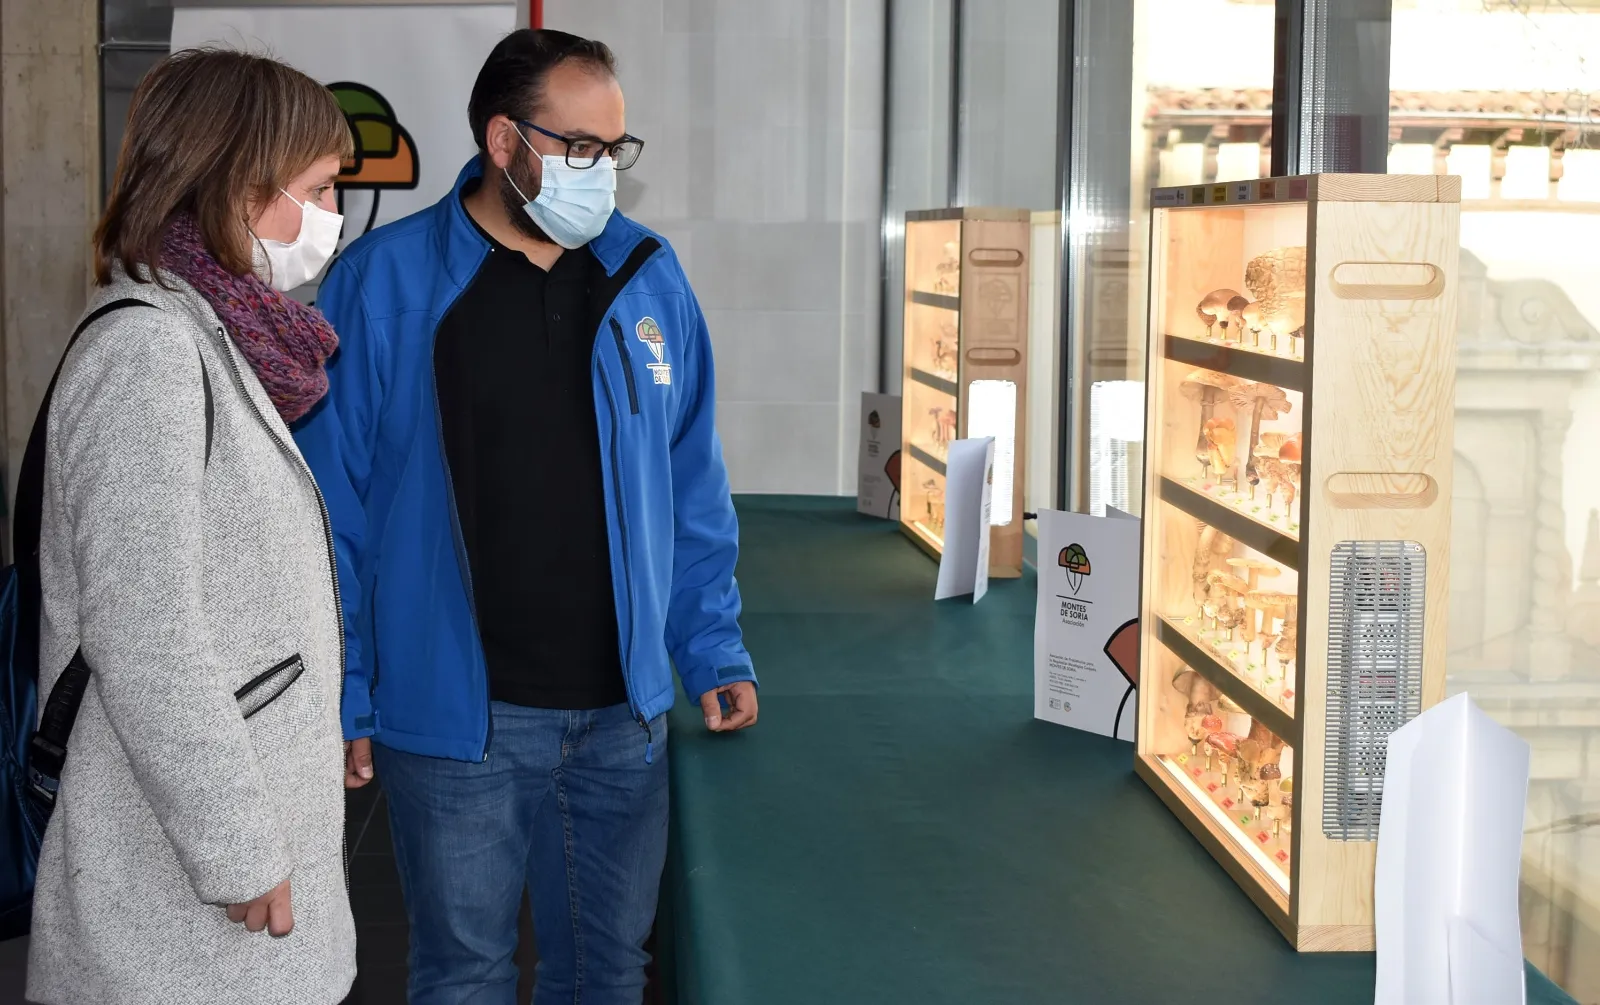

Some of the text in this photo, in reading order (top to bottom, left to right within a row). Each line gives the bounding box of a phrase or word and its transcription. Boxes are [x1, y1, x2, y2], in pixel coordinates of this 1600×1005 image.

[1061, 601, 1087, 613] MONTES
[1060, 608, 1089, 621] DE SORIA
